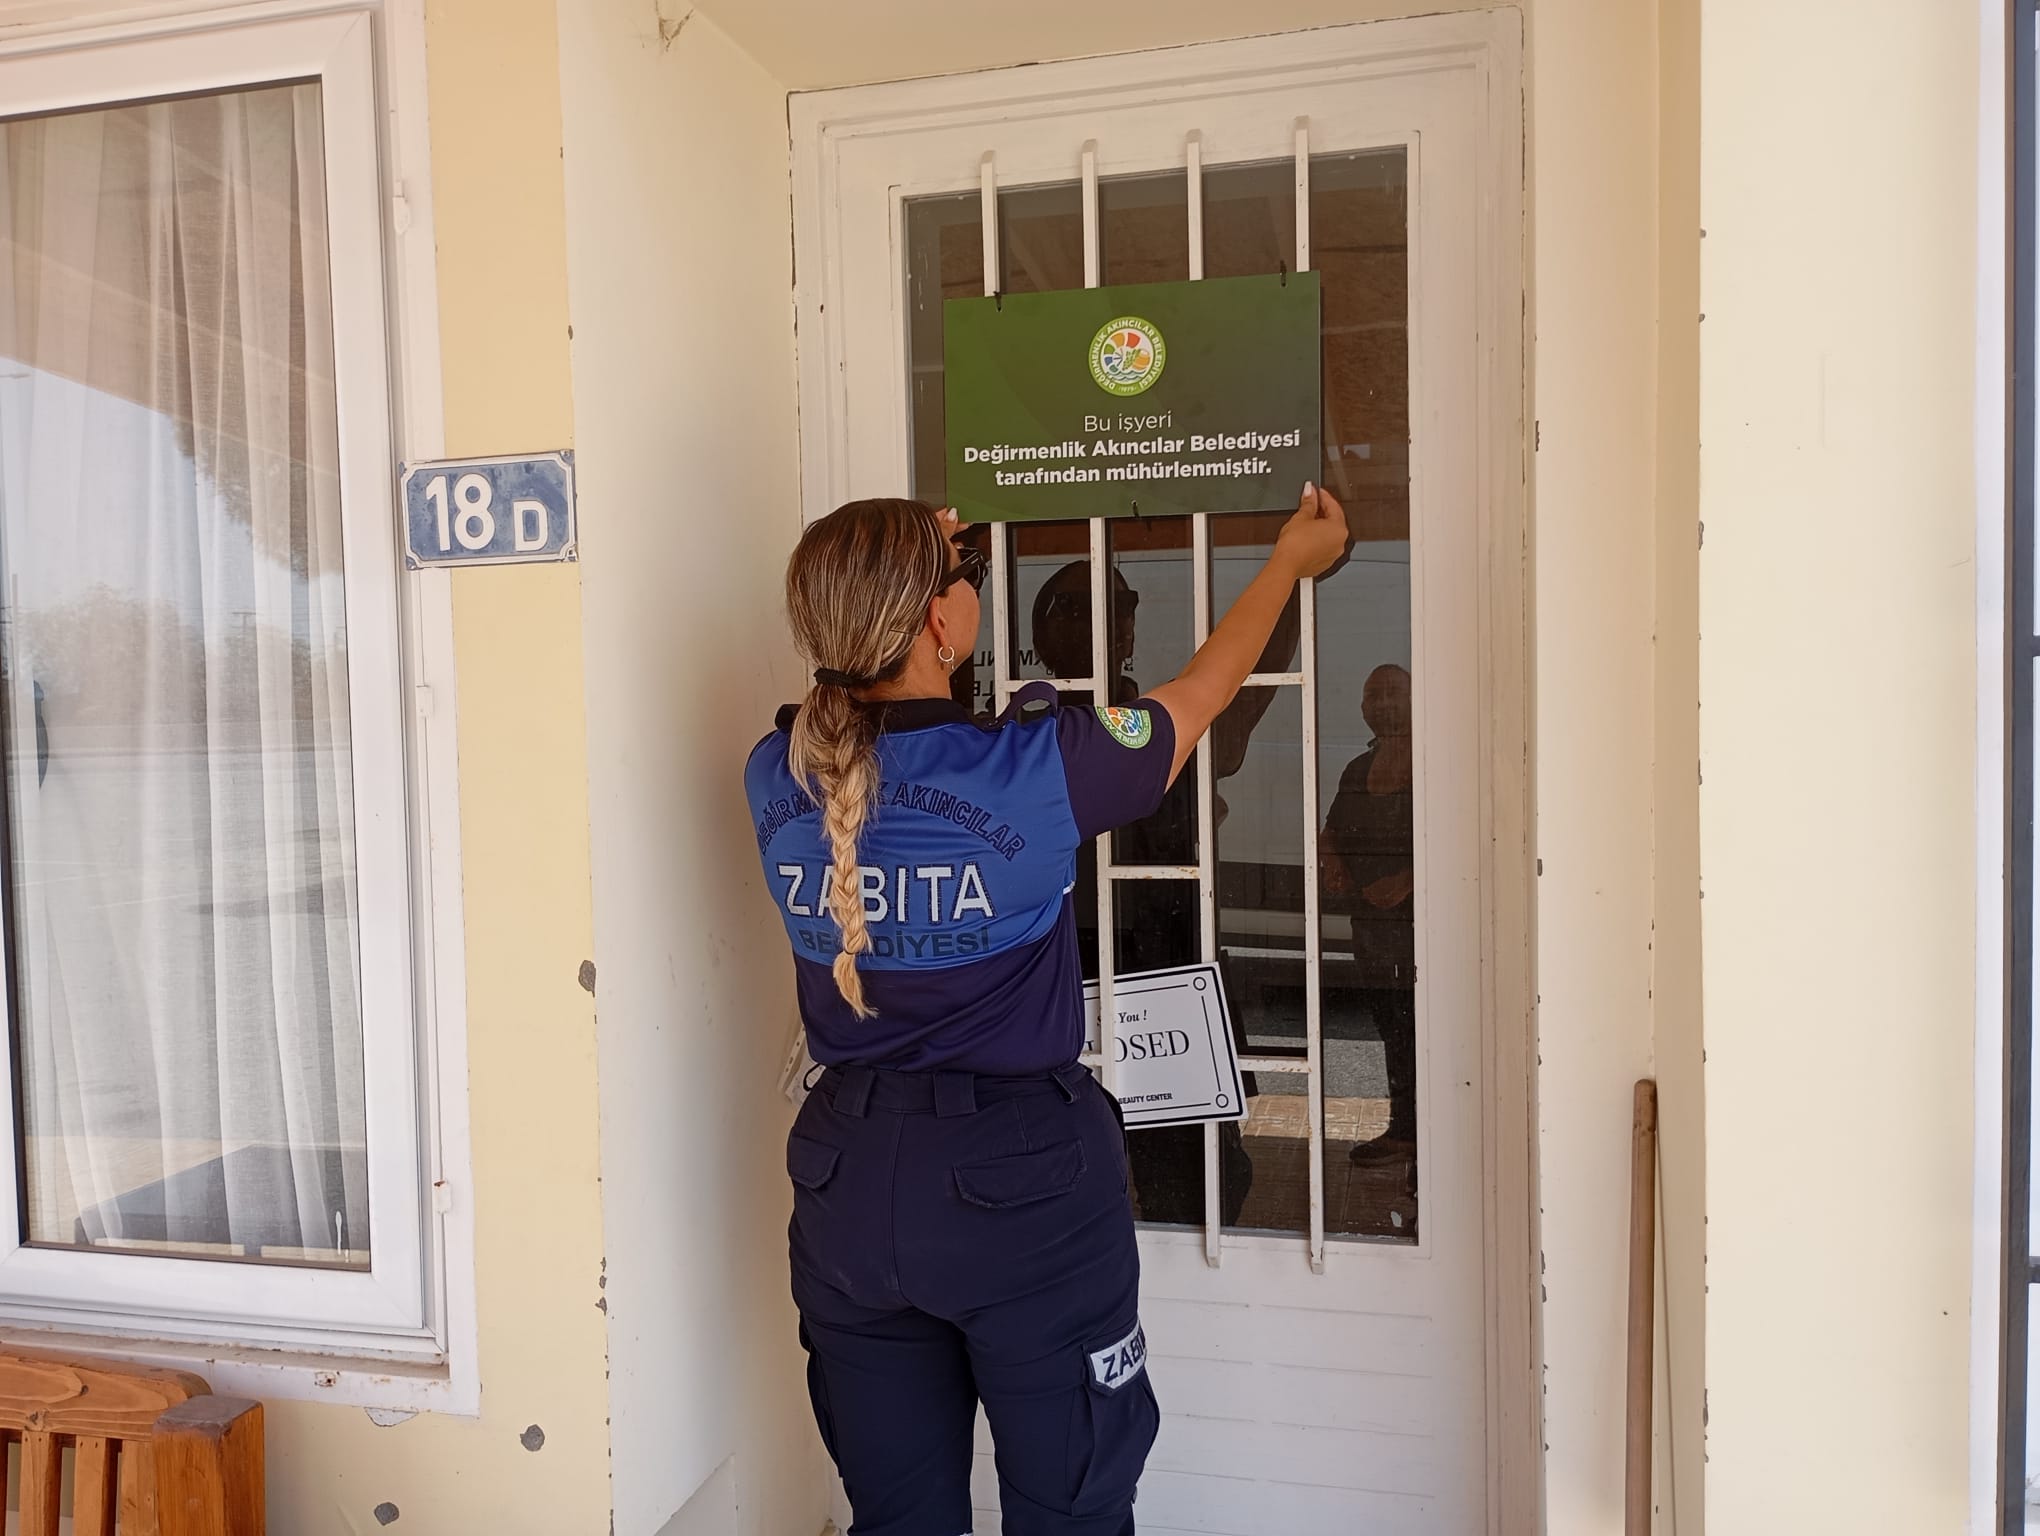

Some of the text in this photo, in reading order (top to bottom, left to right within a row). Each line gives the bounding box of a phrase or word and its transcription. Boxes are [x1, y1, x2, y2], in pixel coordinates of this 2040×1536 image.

[1084, 410, 1172, 433] Bu işyeri
[964, 429, 1301, 465] Değirmenlik Akıncılar Belediyesi
[995, 457, 1273, 486] tarafından mühürlenmiştir.
[425, 473, 549, 552] 18 D
[891, 781, 1026, 862] AKINCILAR
[799, 926, 990, 959] BEDİYESİ
[1118, 1011, 1140, 1024] You
[1146, 1092, 1173, 1102] CENTER
